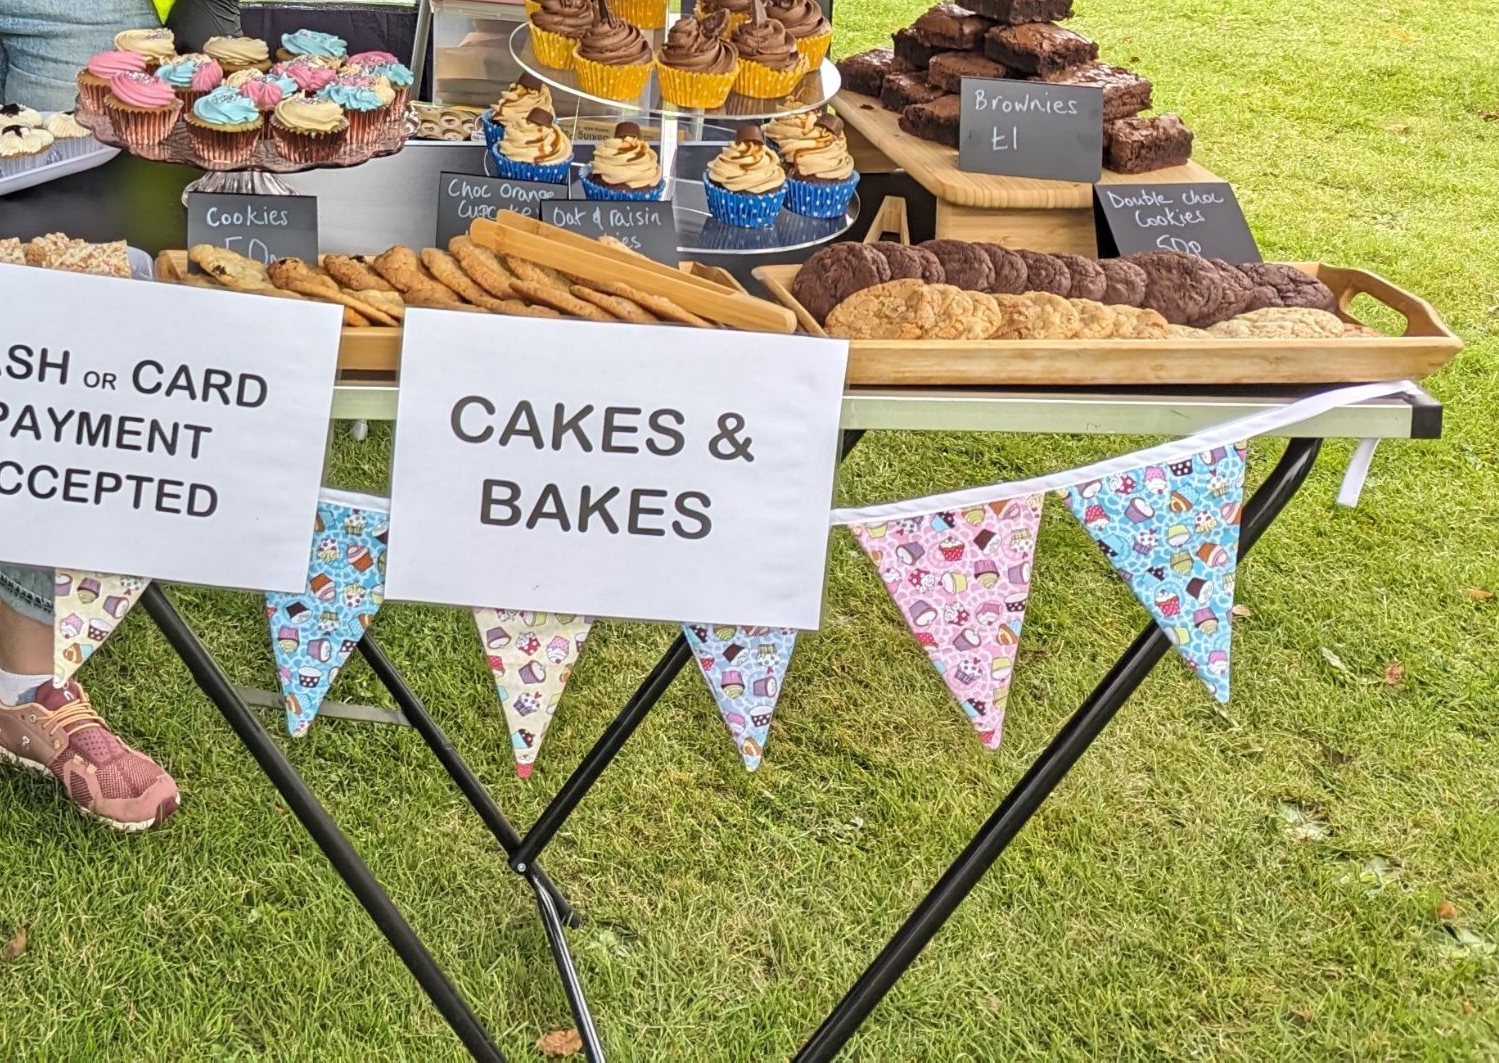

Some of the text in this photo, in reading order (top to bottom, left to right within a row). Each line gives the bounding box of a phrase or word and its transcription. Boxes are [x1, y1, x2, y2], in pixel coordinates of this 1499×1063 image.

[974, 88, 1078, 115] Brownies
[991, 125, 1018, 152] £1
[448, 178, 491, 198] Choc
[1107, 189, 1173, 209] Double
[206, 204, 288, 227] Cookies
[553, 206, 581, 227] Oat
[1134, 206, 1207, 228] Cookies
[83, 370, 117, 391] OR
[132, 359, 268, 409] CARD
[450, 394, 755, 463] CAKES &
[479, 477, 713, 540] BAKES
